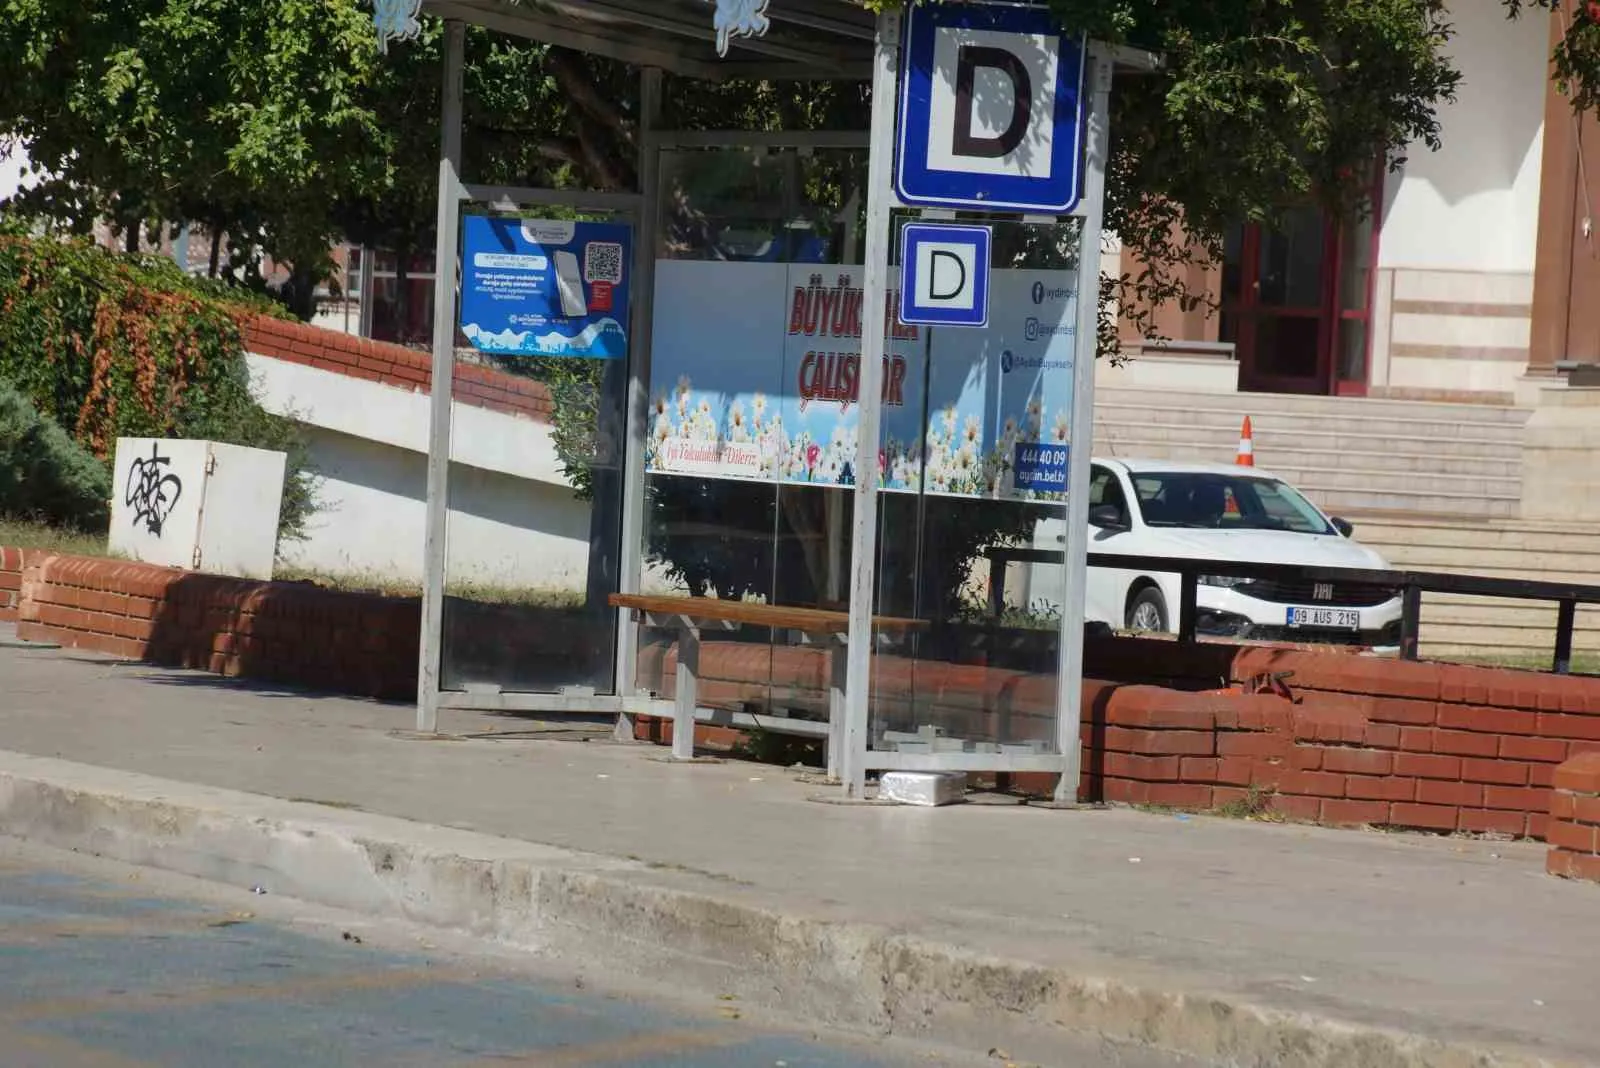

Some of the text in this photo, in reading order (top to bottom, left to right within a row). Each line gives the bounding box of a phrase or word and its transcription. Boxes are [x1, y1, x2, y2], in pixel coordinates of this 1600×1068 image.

[952, 45, 1032, 158] D
[930, 250, 965, 299] D
[1022, 449, 1066, 465] 444 40 09
[1295, 609, 1357, 626] 09 AUS 215
